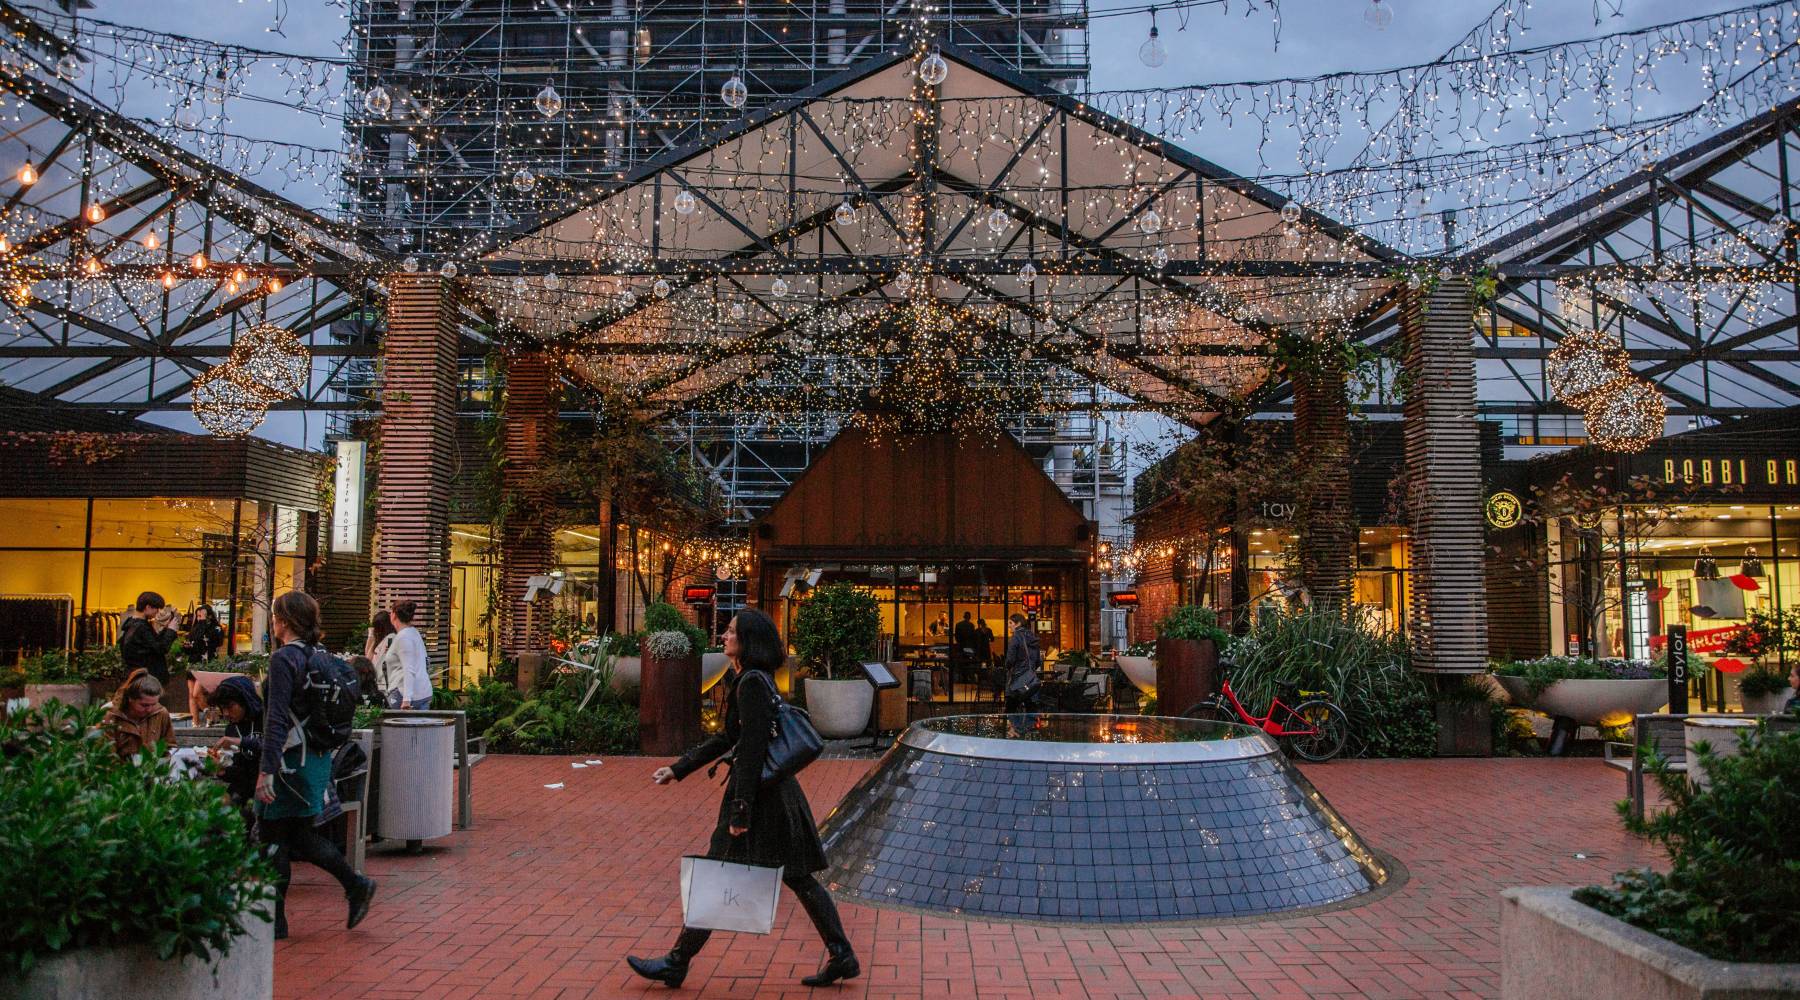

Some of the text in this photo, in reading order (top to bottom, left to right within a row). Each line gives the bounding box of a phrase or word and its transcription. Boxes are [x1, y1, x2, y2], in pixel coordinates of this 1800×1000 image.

[1664, 458, 1798, 485] BOBBI BR
[1261, 501, 1296, 521] tay
[342, 510, 350, 545] hogan
[1673, 632, 1686, 685] taylor
[723, 887, 740, 906] tk
